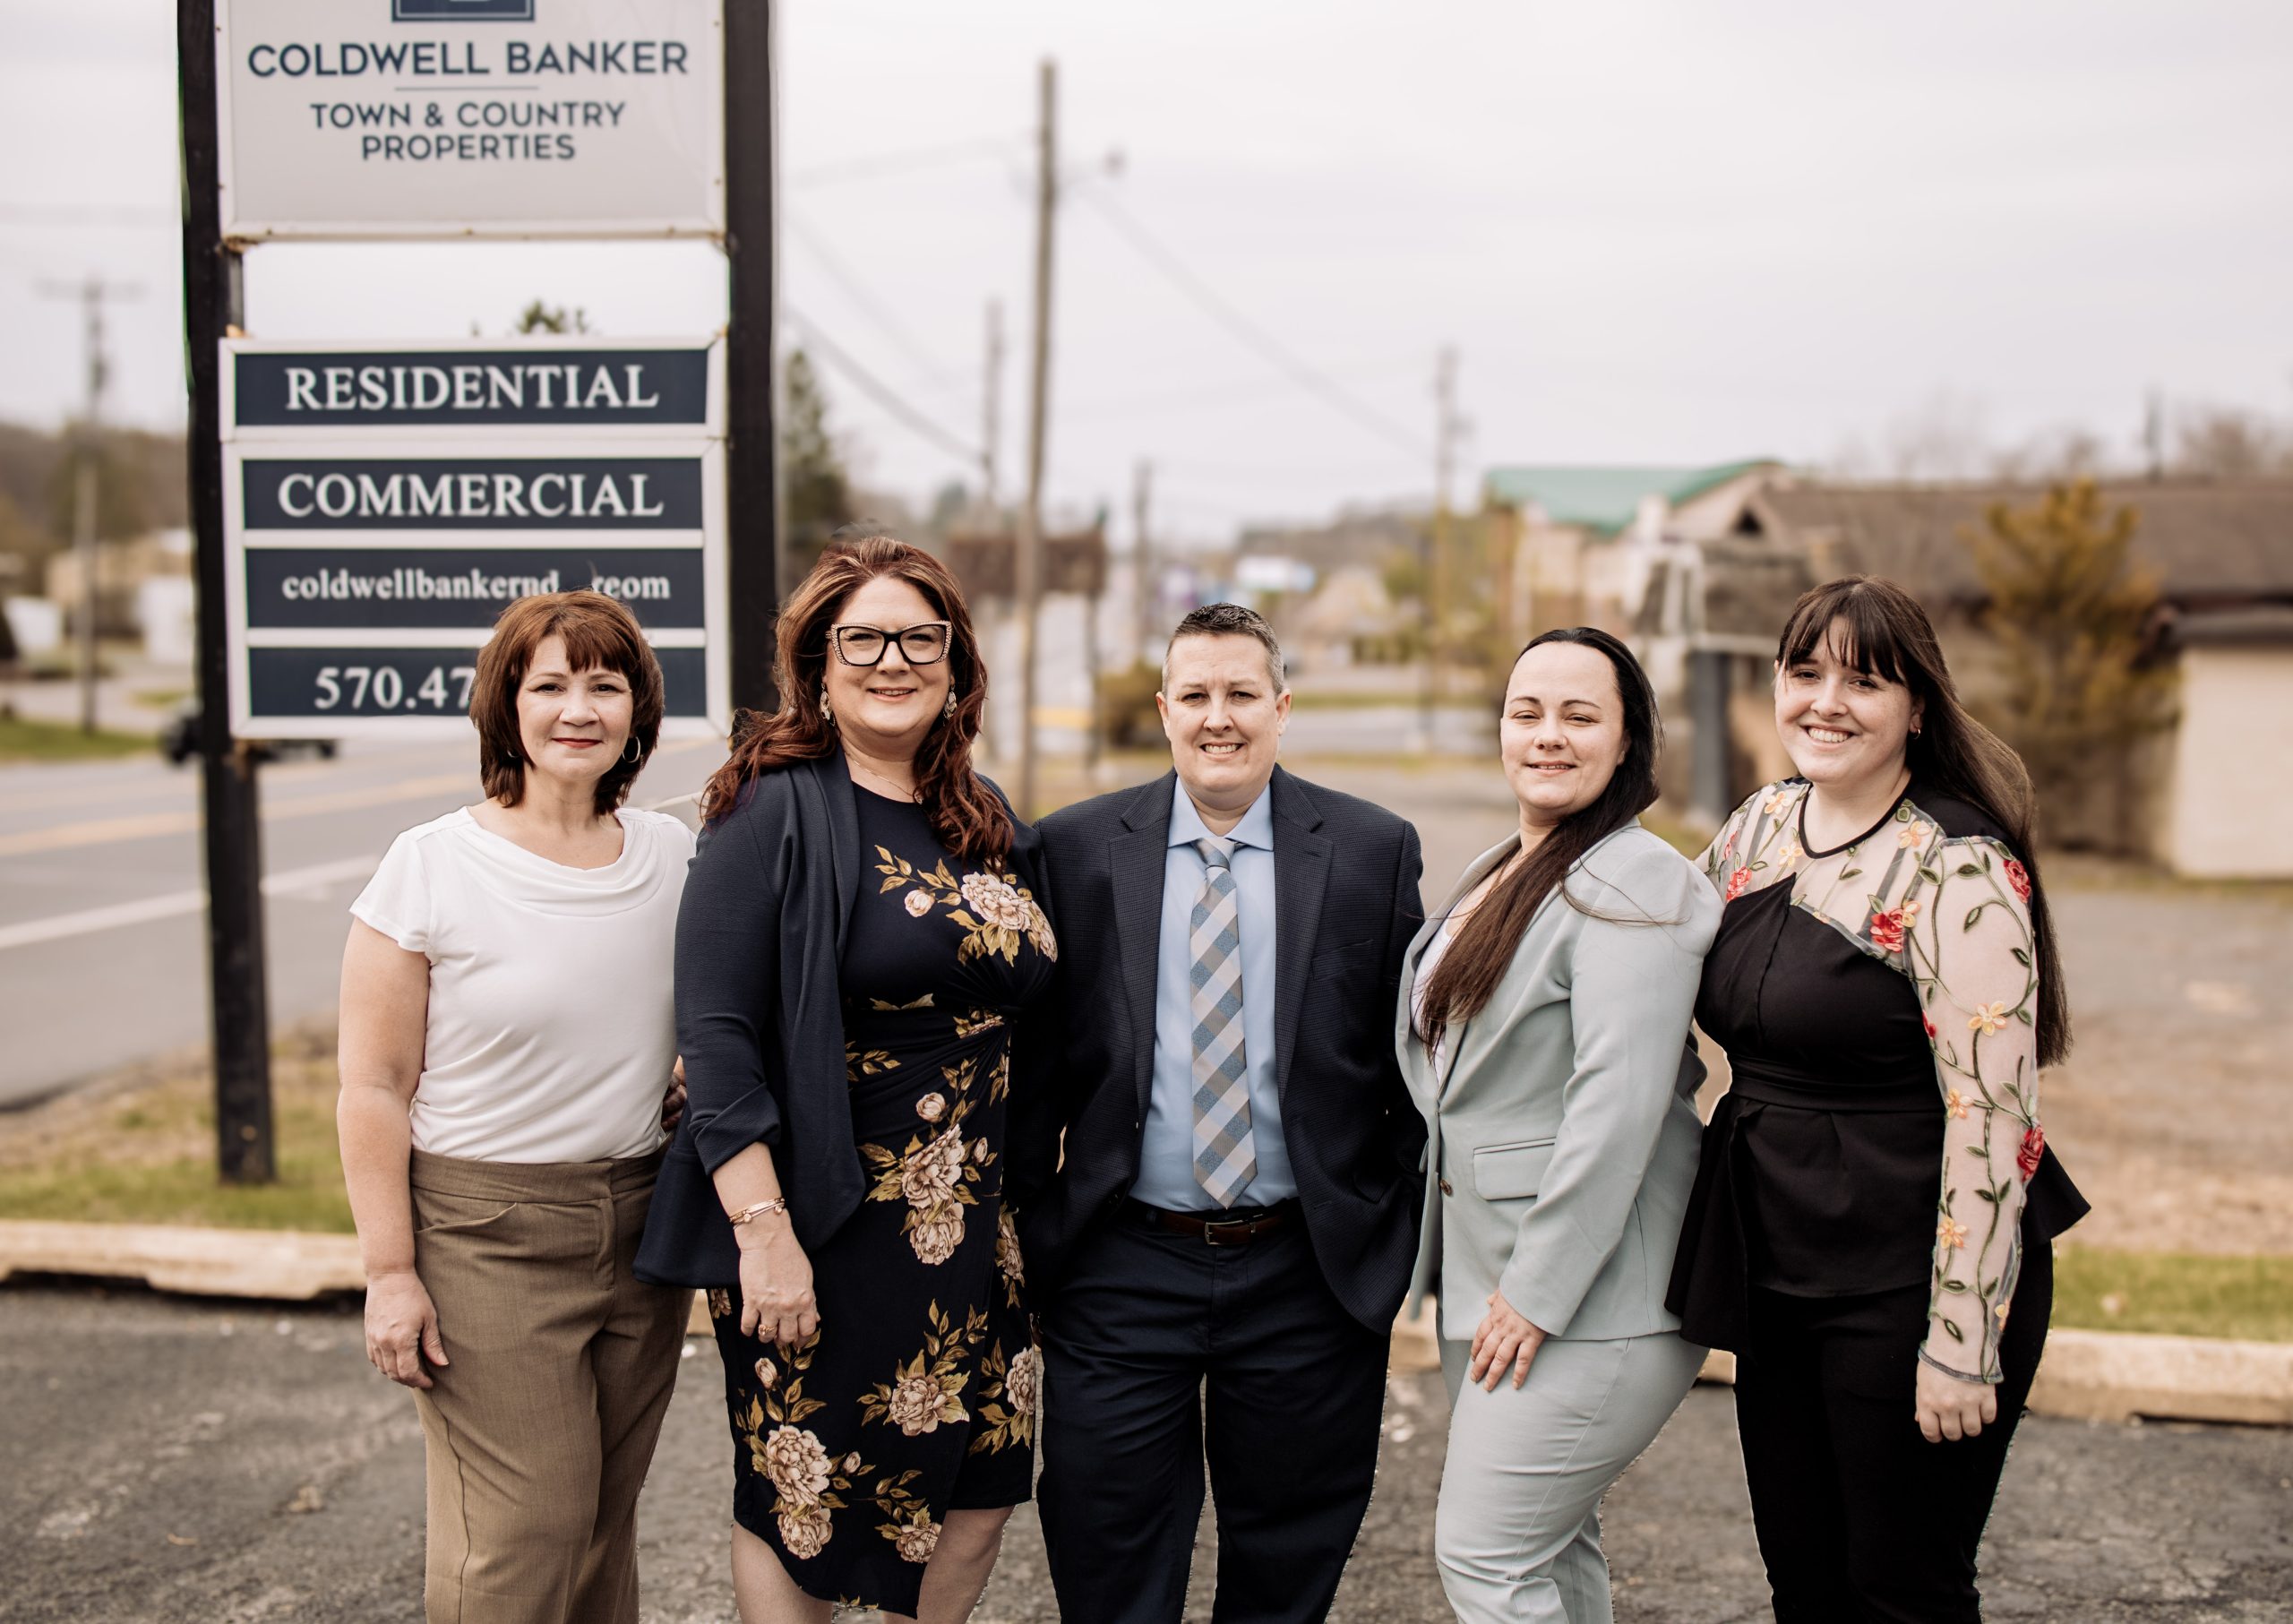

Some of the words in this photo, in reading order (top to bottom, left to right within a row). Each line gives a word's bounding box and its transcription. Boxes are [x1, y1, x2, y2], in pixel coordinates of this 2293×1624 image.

[247, 41, 491, 78] COLDWELL
[506, 40, 689, 74] BANKER
[310, 103, 411, 129] TOWN
[424, 102, 444, 128] &
[457, 101, 625, 128] COUNTRY
[362, 133, 576, 161] PROPERTIES
[285, 365, 659, 410] RESIDENTIAL
[278, 473, 665, 517] COMMERCIAL
[314, 666, 477, 709] 570.47
